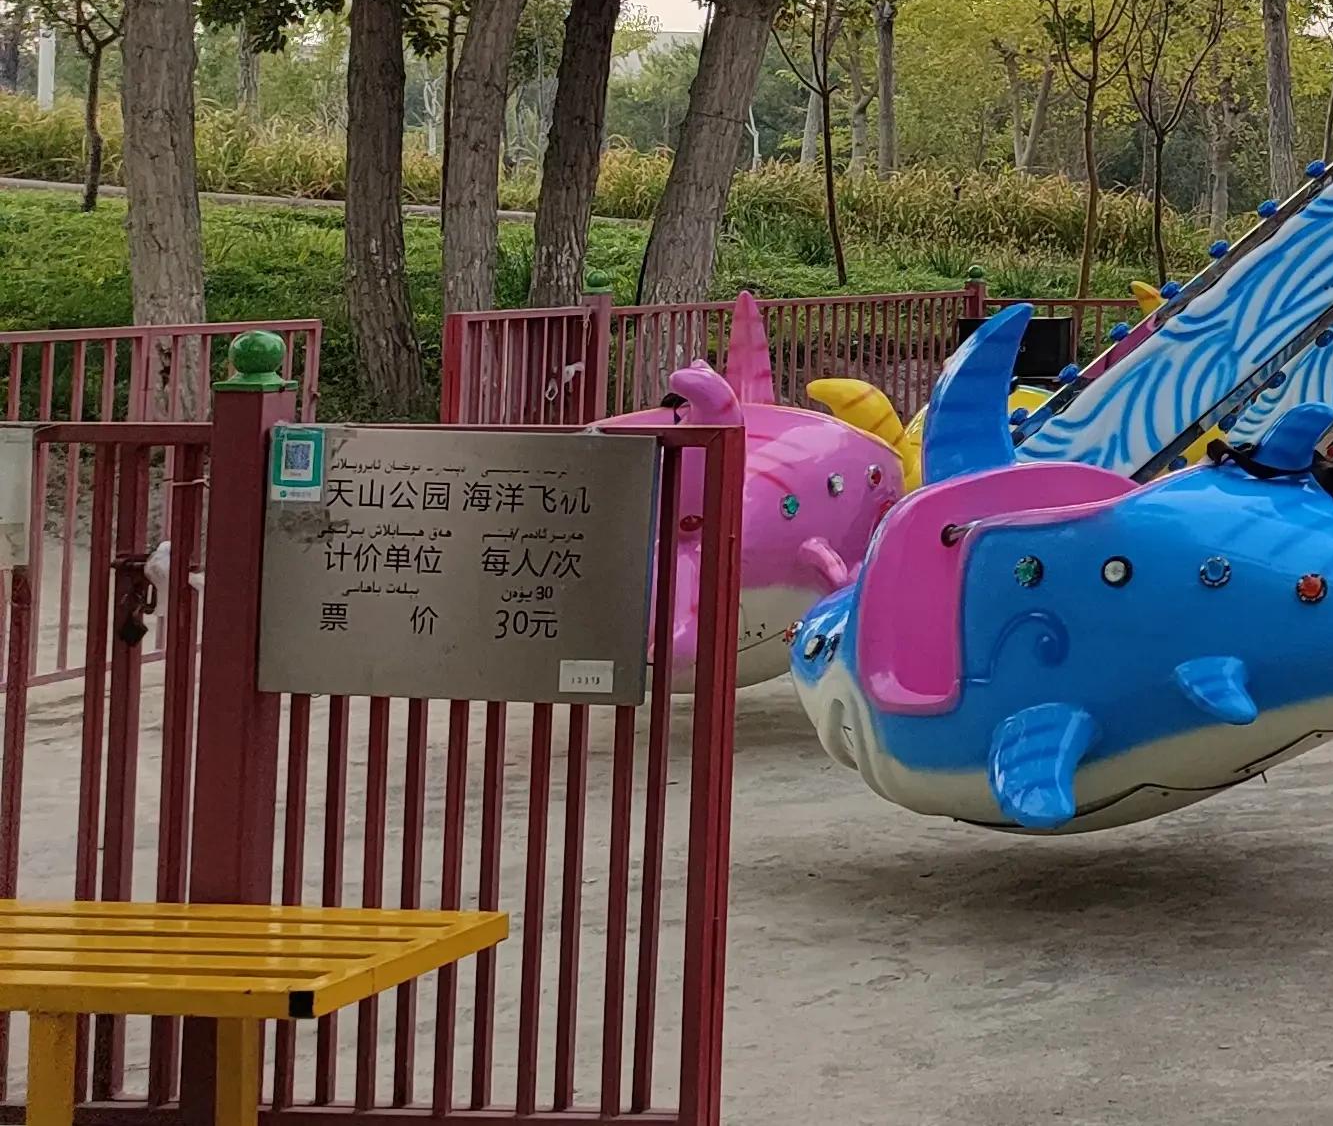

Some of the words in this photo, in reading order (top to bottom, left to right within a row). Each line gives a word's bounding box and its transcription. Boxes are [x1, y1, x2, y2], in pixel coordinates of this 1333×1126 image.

[325, 478, 450, 512] 天山公园
[462, 481, 592, 515] 海洋飞机
[323, 542, 443, 575] 计价单位
[481, 546, 582, 579] 每人/次
[319, 602, 349, 632] 票
[410, 605, 439, 636] 价
[494, 609, 558, 639] 30元
